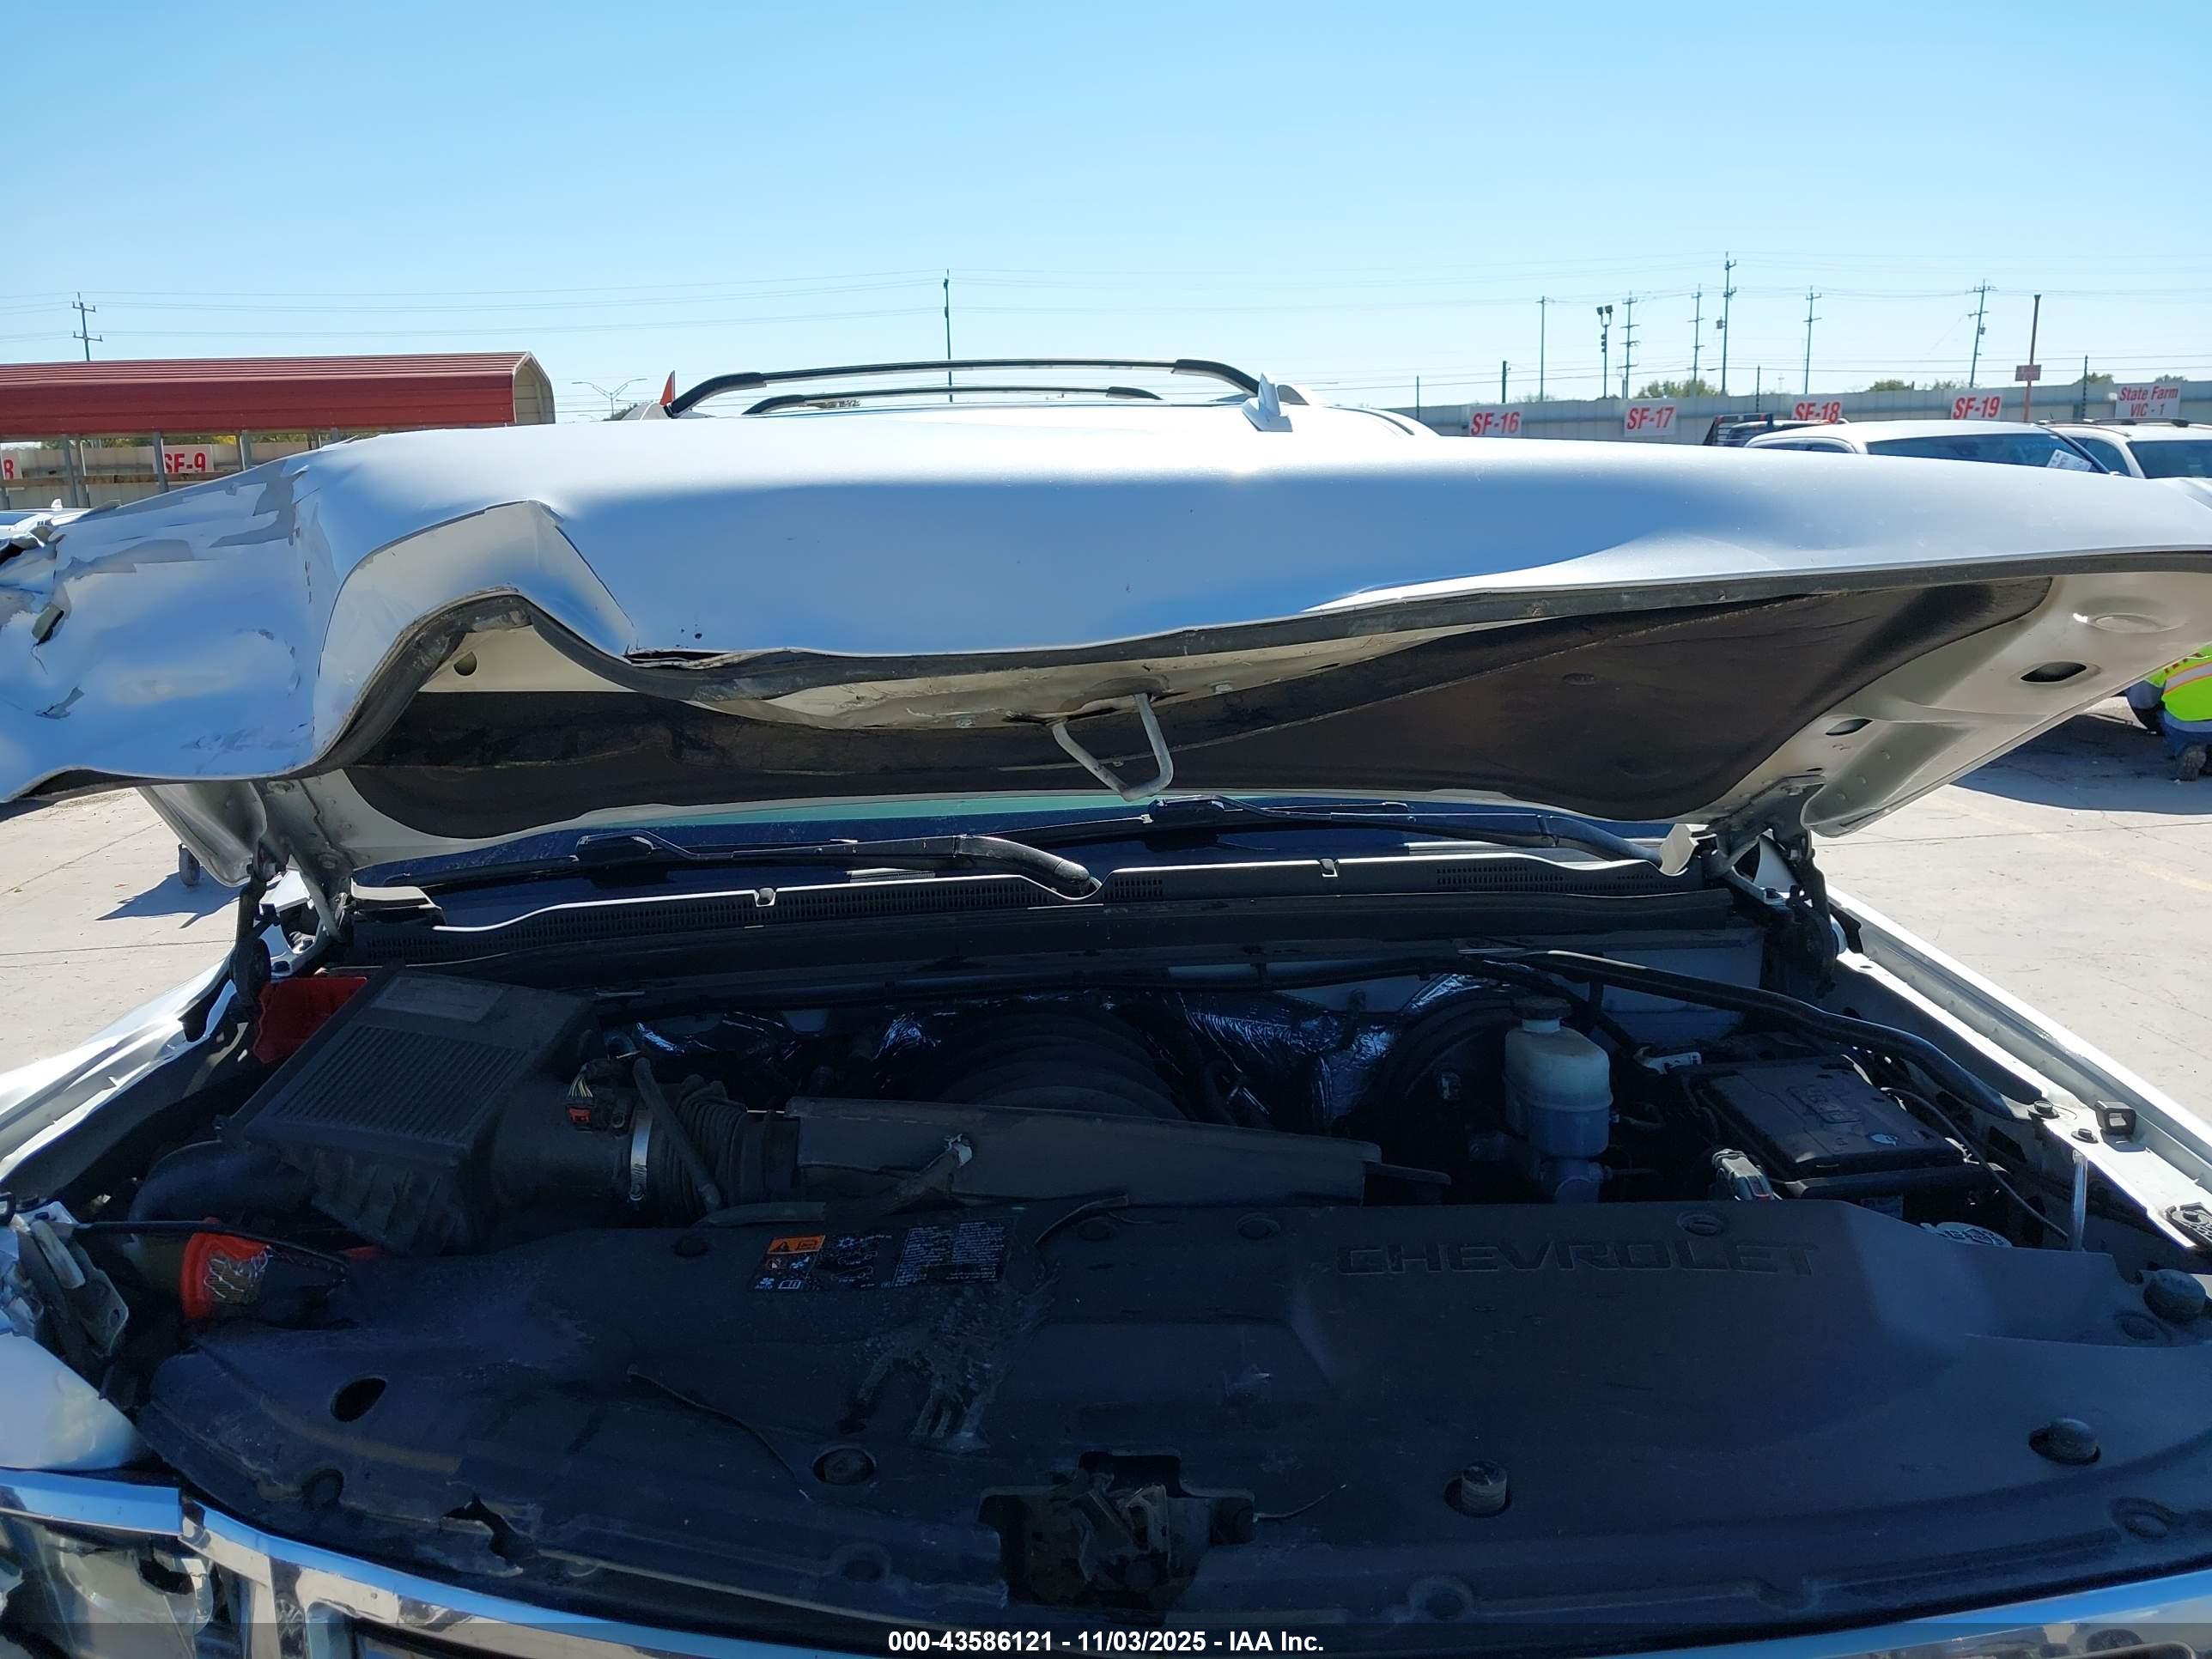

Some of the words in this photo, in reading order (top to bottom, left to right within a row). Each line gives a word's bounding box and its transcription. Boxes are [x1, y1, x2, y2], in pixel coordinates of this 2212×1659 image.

[2119, 386, 2148, 401] State
[2150, 386, 2179, 400] Farm
[1626, 406, 1674, 430] SF-17
[1794, 401, 1841, 422] SF-18
[1953, 396, 2001, 419] SF-19
[2130, 403, 2148, 417] VIC
[2159, 404, 2165, 416] 1
[1470, 411, 1520, 436] SF-16
[164, 453, 206, 474] SF-9
[1339, 1241, 1819, 1275] CHEVROLET
